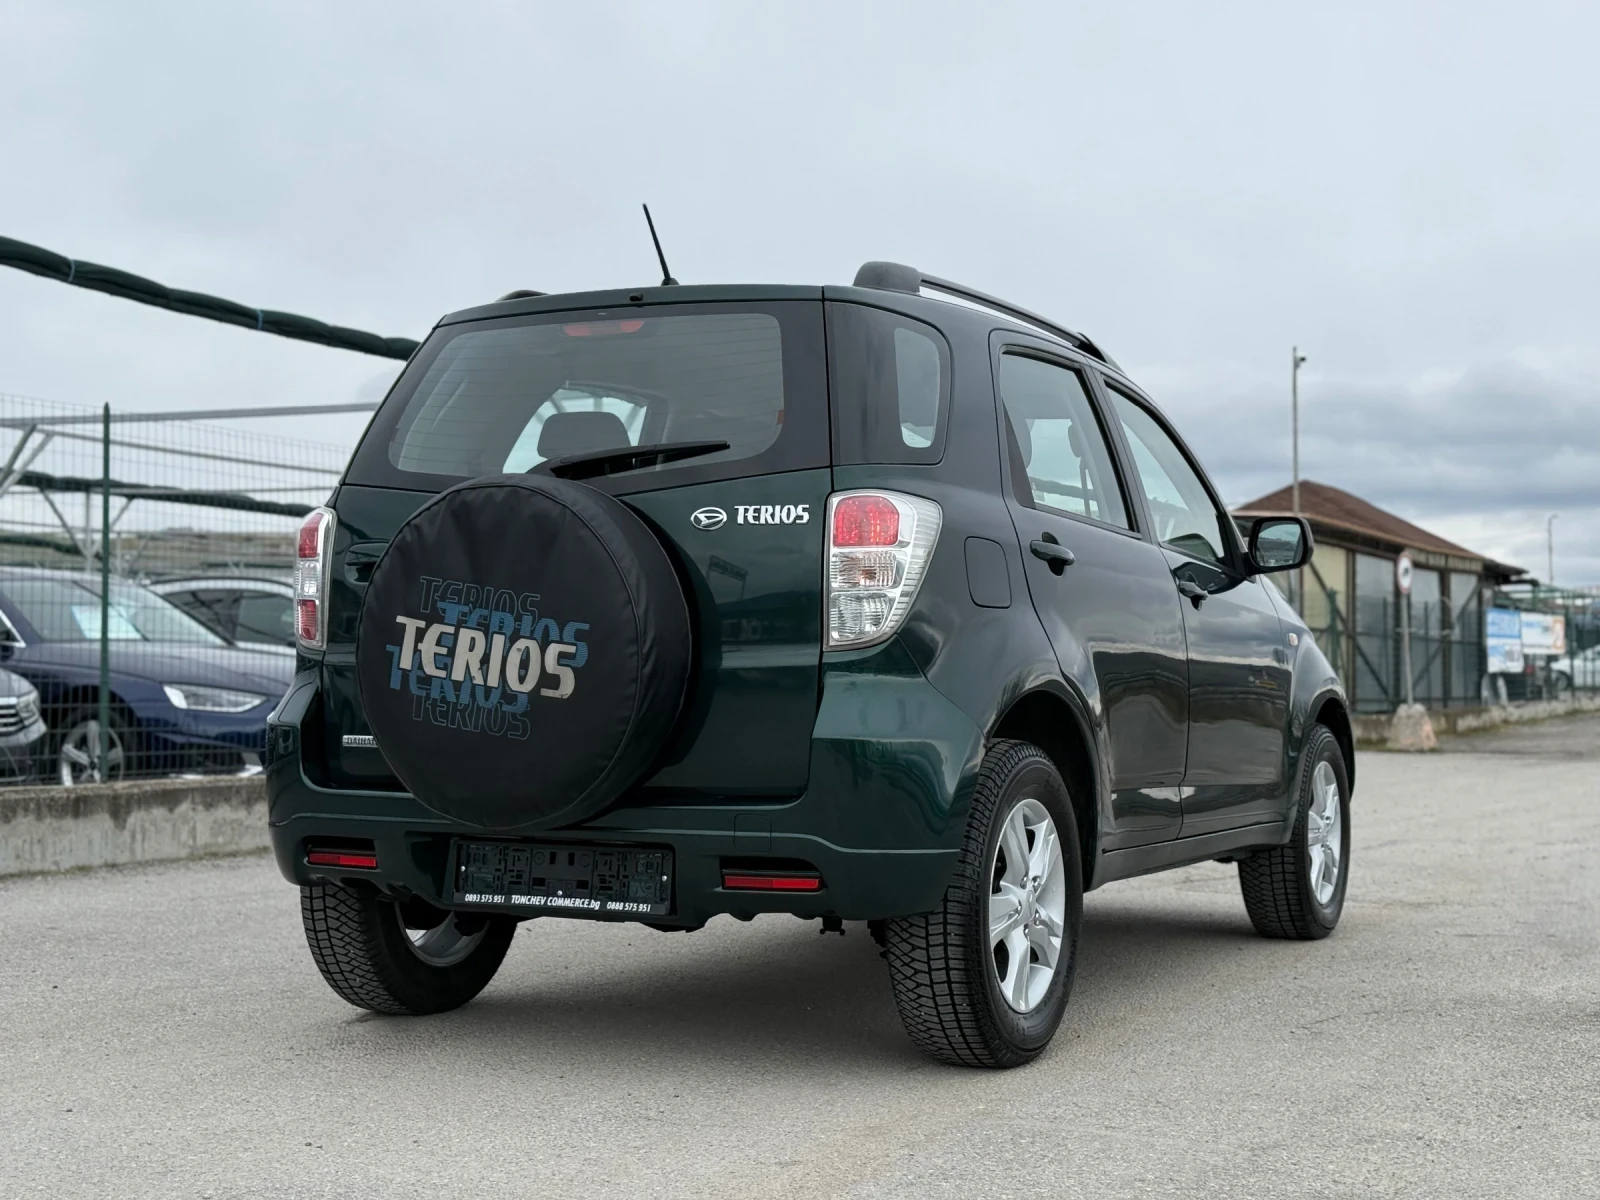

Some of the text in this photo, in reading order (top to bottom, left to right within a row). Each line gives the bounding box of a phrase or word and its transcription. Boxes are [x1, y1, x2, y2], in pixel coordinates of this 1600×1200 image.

[734, 504, 810, 525] TERIOS
[420, 576, 540, 631] TERIOS
[395, 615, 577, 699] TERIOS
[465, 893, 651, 912] 0893 575 951 TONCHEV COMMERCE.bg 0888 575 951
